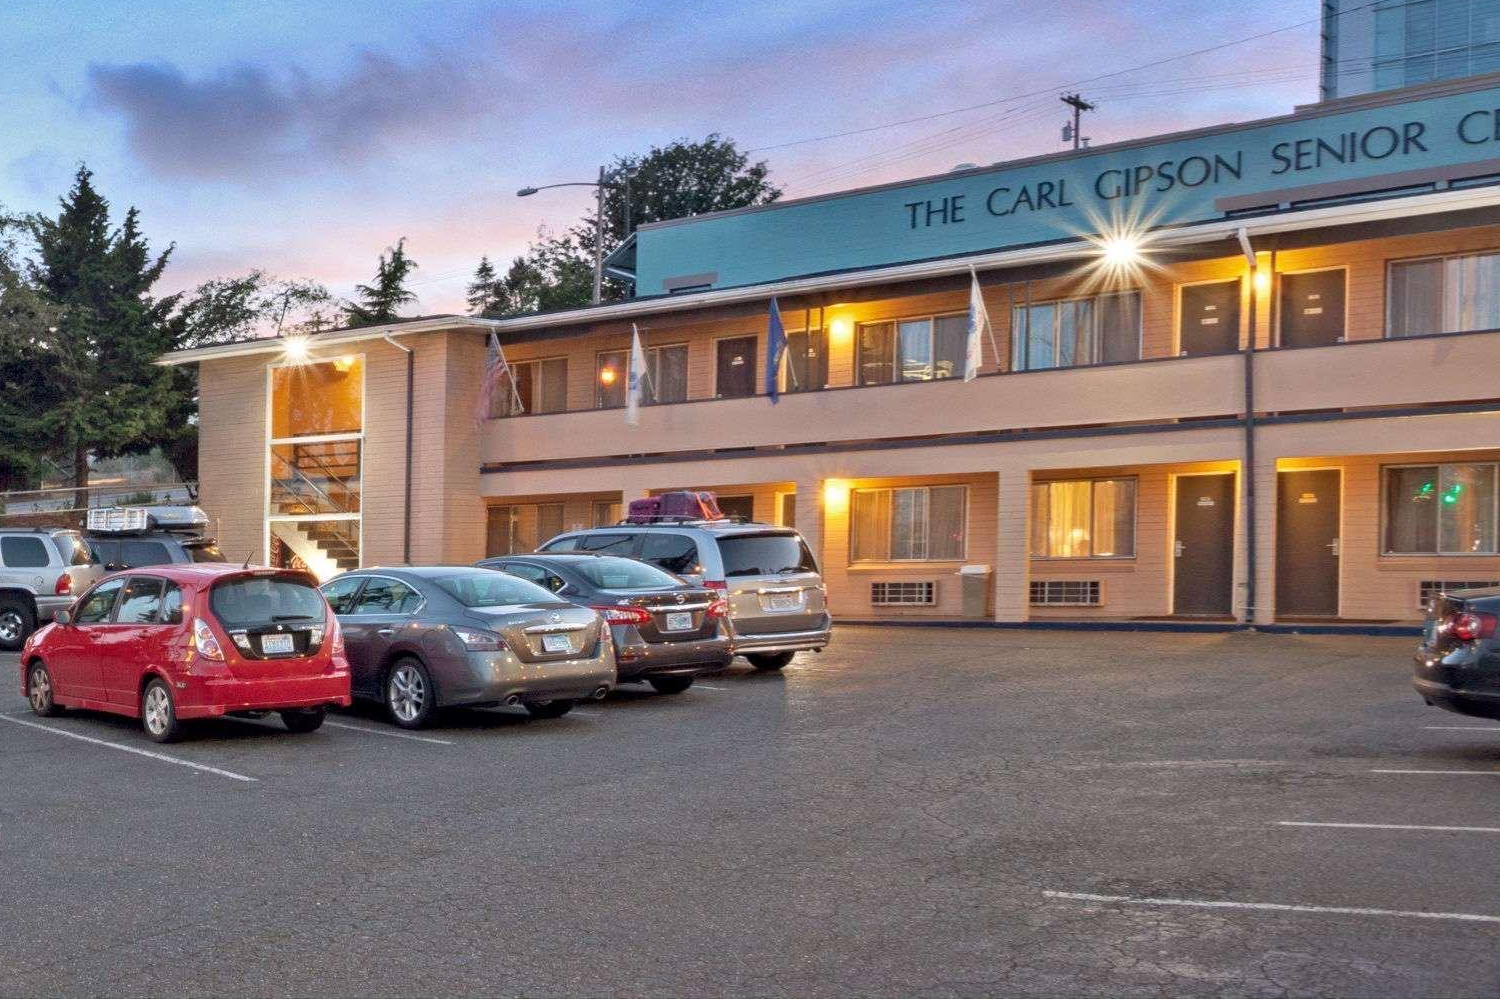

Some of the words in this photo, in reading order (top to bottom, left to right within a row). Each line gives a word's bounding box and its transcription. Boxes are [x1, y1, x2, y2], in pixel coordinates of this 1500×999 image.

[904, 194, 966, 229] THE
[986, 179, 1073, 216] CARL
[1094, 150, 1243, 200] GIPSON
[1270, 121, 1428, 175] SENIOR
